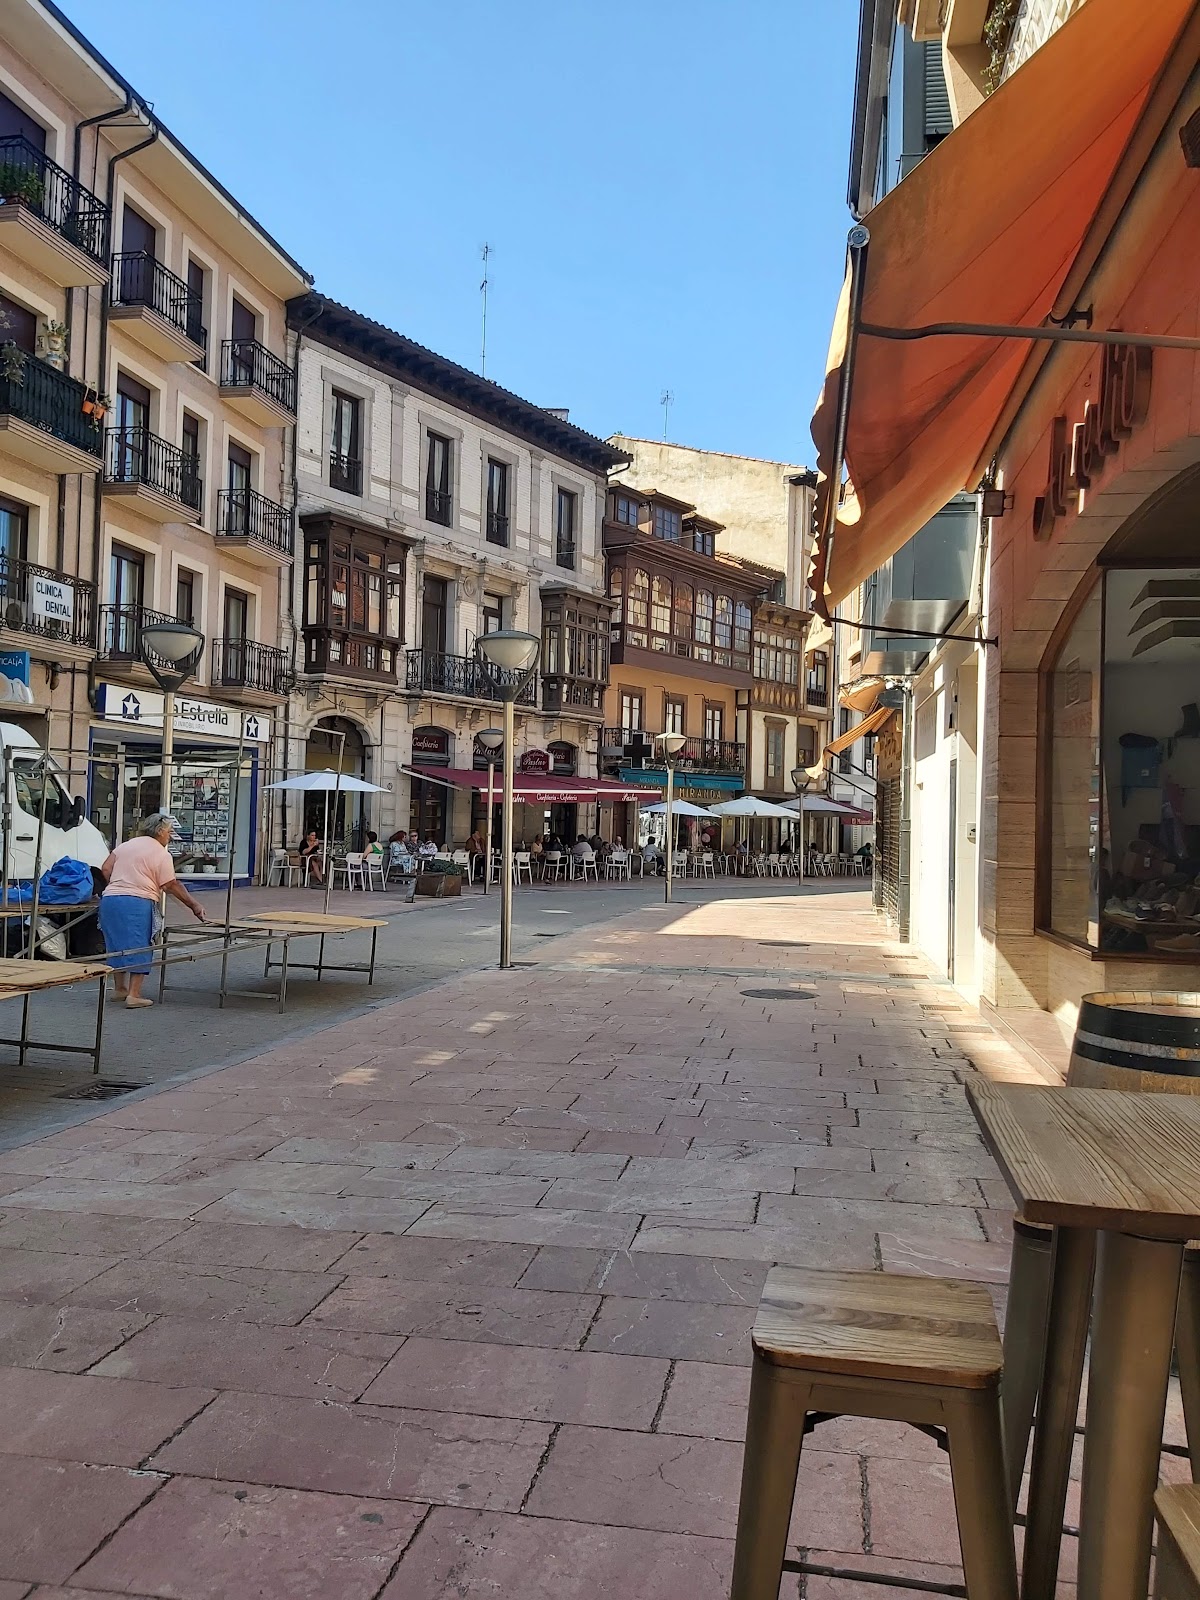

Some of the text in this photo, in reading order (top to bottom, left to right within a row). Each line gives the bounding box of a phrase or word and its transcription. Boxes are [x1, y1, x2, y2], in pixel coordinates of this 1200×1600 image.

[36, 581, 62, 599] CLINICA
[45, 600, 71, 617] DENTAL
[181, 701, 228, 725] Estrella
[679, 787, 722, 799] MIRANDA
